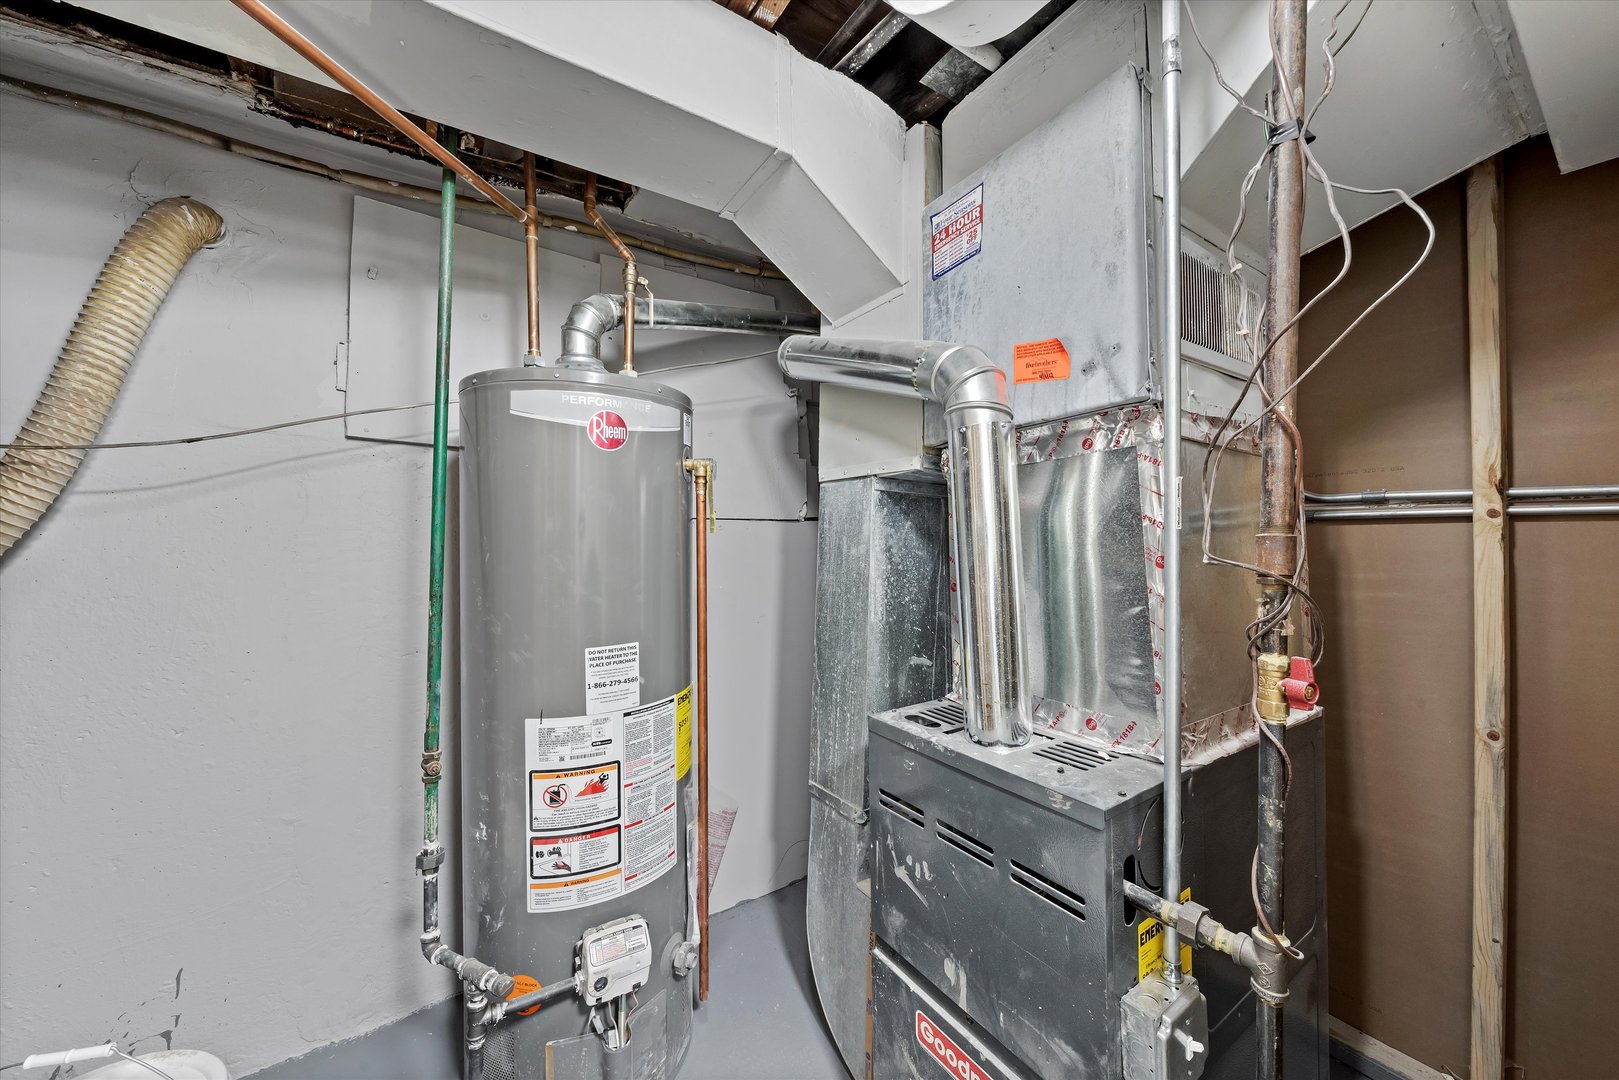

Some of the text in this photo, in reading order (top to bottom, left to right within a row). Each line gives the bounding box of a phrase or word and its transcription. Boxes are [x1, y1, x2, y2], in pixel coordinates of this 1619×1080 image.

[934, 207, 980, 245] 24 HOUR
[561, 394, 652, 413] PERFORMANCE
[592, 410, 626, 443] Rheem
[612, 658, 637, 666] PURCHASE
[587, 676, 639, 690] 1-866-279-4566
[563, 769, 596, 778] WARNING
[564, 835, 591, 843] DANGER
